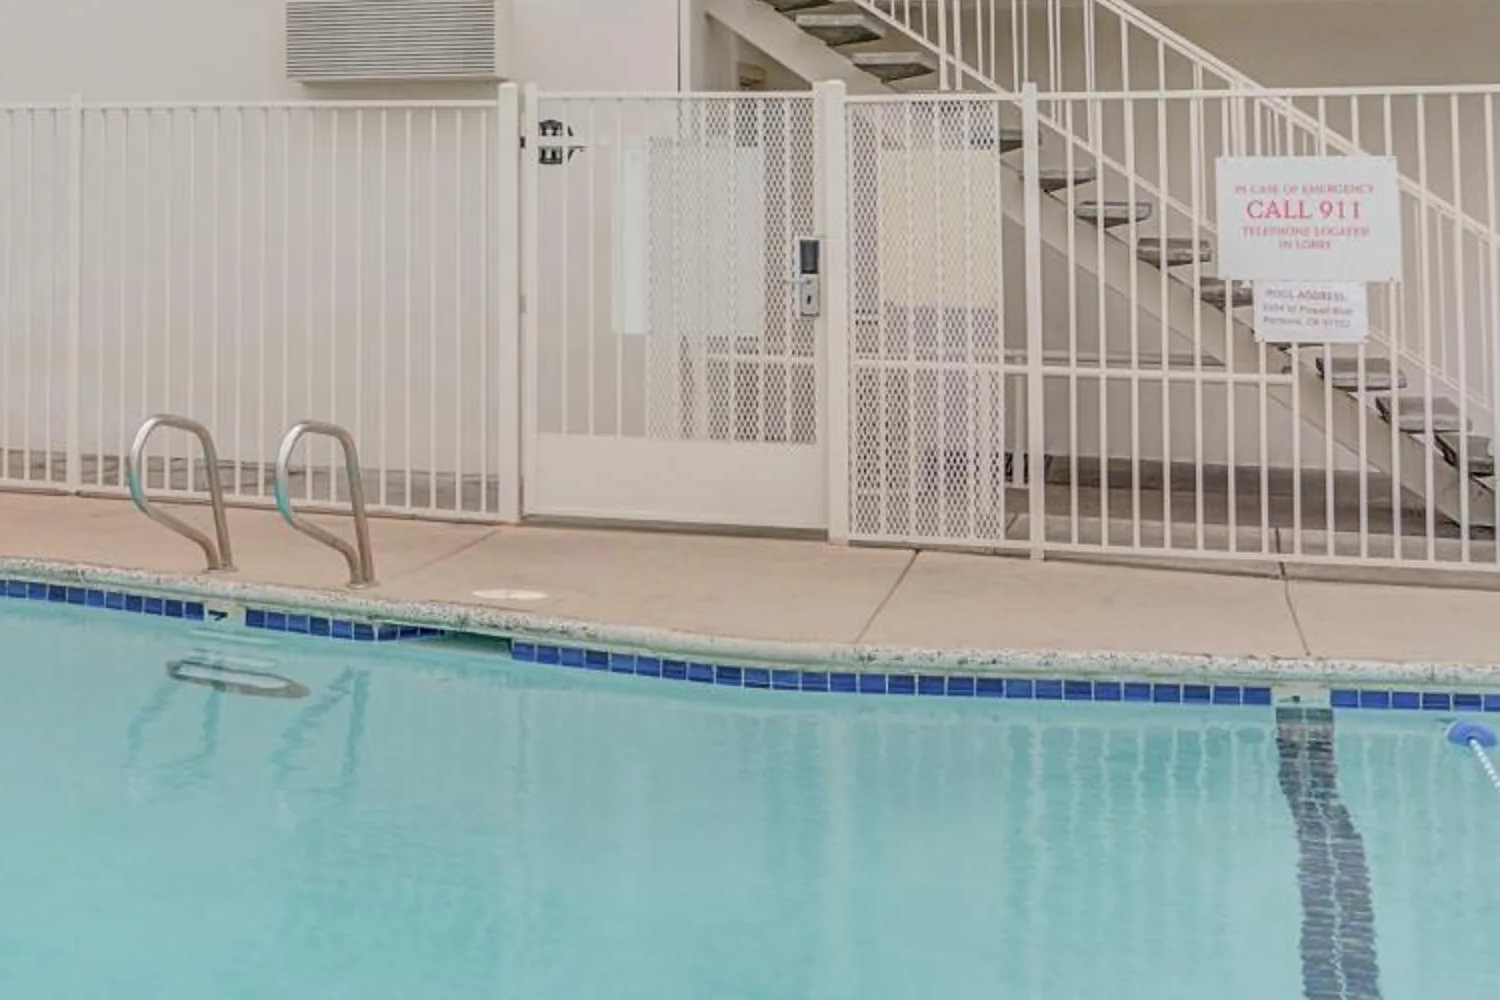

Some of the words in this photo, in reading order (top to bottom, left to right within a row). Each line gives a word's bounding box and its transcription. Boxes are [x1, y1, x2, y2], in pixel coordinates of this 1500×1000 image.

[1301, 183, 1374, 195] EMERGENCY
[1246, 199, 1314, 219] CALL
[1319, 200, 1361, 219] 911
[1242, 226, 1311, 237] TELEPHONE
[1314, 226, 1370, 238] LOCATED
